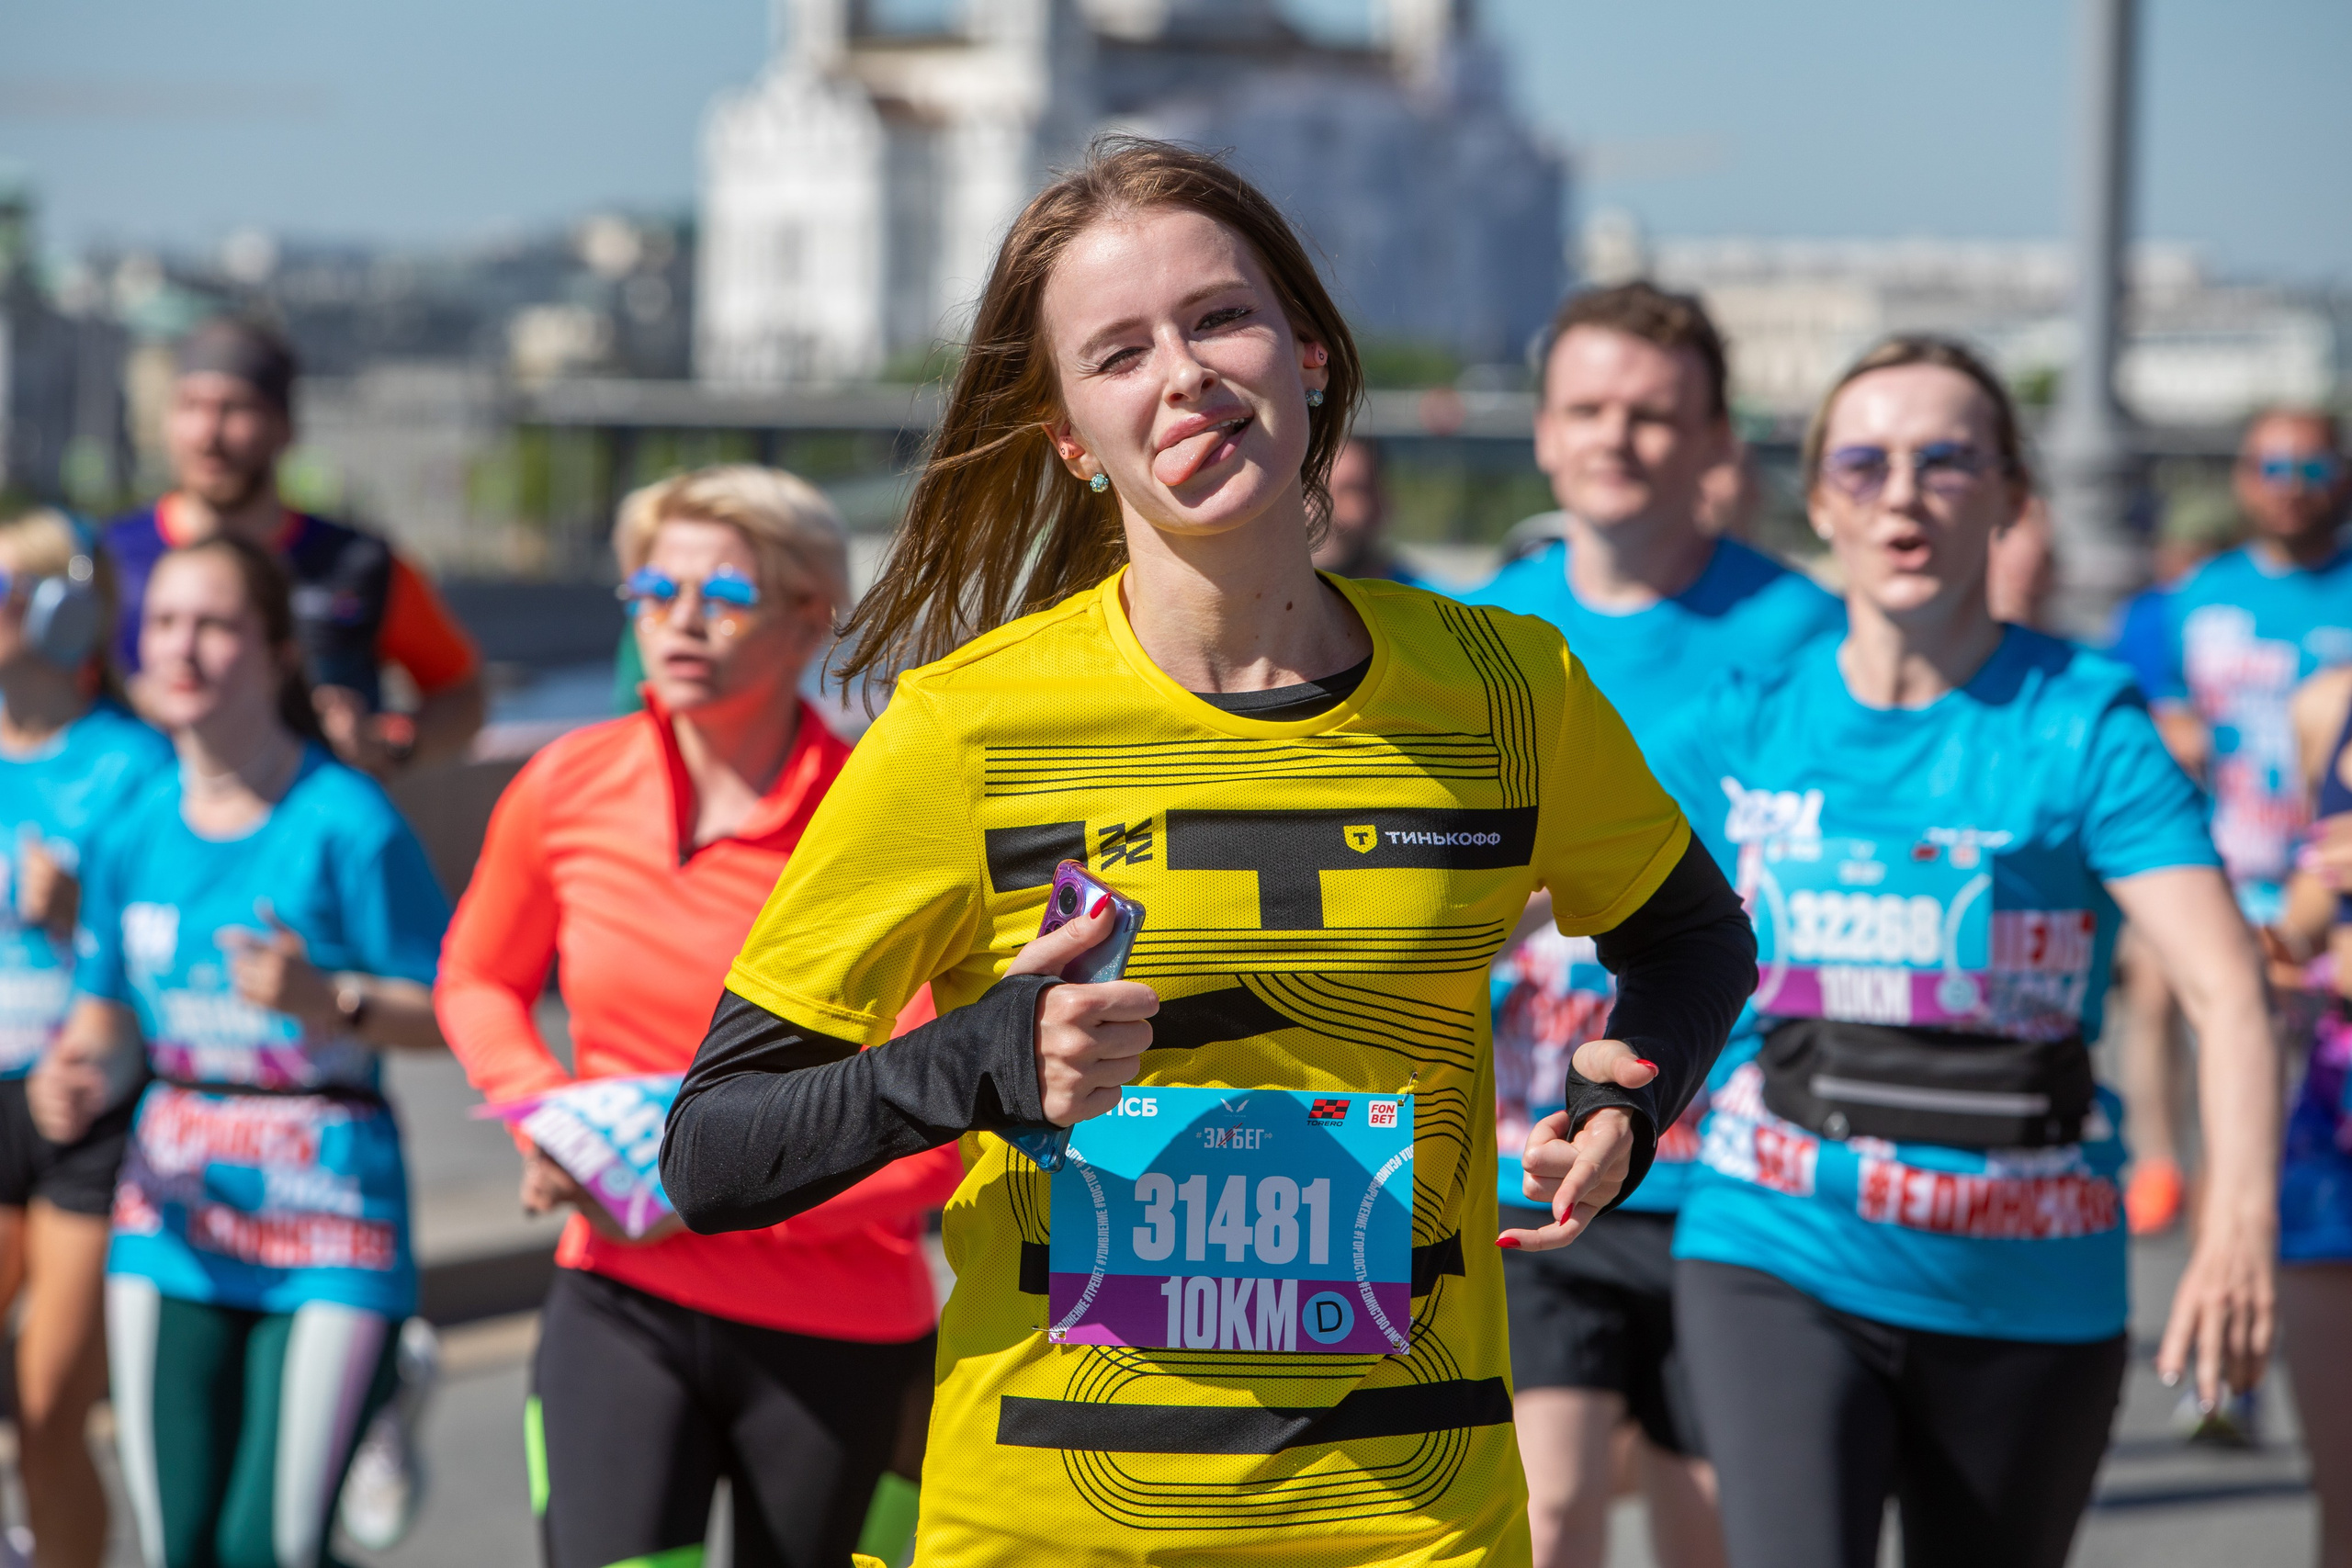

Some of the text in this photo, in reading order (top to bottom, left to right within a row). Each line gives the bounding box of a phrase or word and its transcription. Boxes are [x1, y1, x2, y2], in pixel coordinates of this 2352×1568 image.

[1385, 831, 1501, 846] ТИНЬКОФФ
[1371, 1104, 1396, 1114] FON
[1371, 1114, 1395, 1124] BET
[1080, 1167, 1106, 1208] #ВОСТОРГ
[1354, 1155, 1402, 1230] #САМОВЫРАЖЕНИЕ
[1095, 1209, 1109, 1265] #УДИВЛЕНИЕ
[1133, 1172, 1330, 1265] 31481
[1352, 1231, 1367, 1281] #ГОРДОСТЬ
[1081, 1266, 1105, 1303] #ТРЕПЕТ
[1358, 1281, 1390, 1330] #ЕДИНСТВО
[1160, 1275, 1343, 1352] 10КМ D
